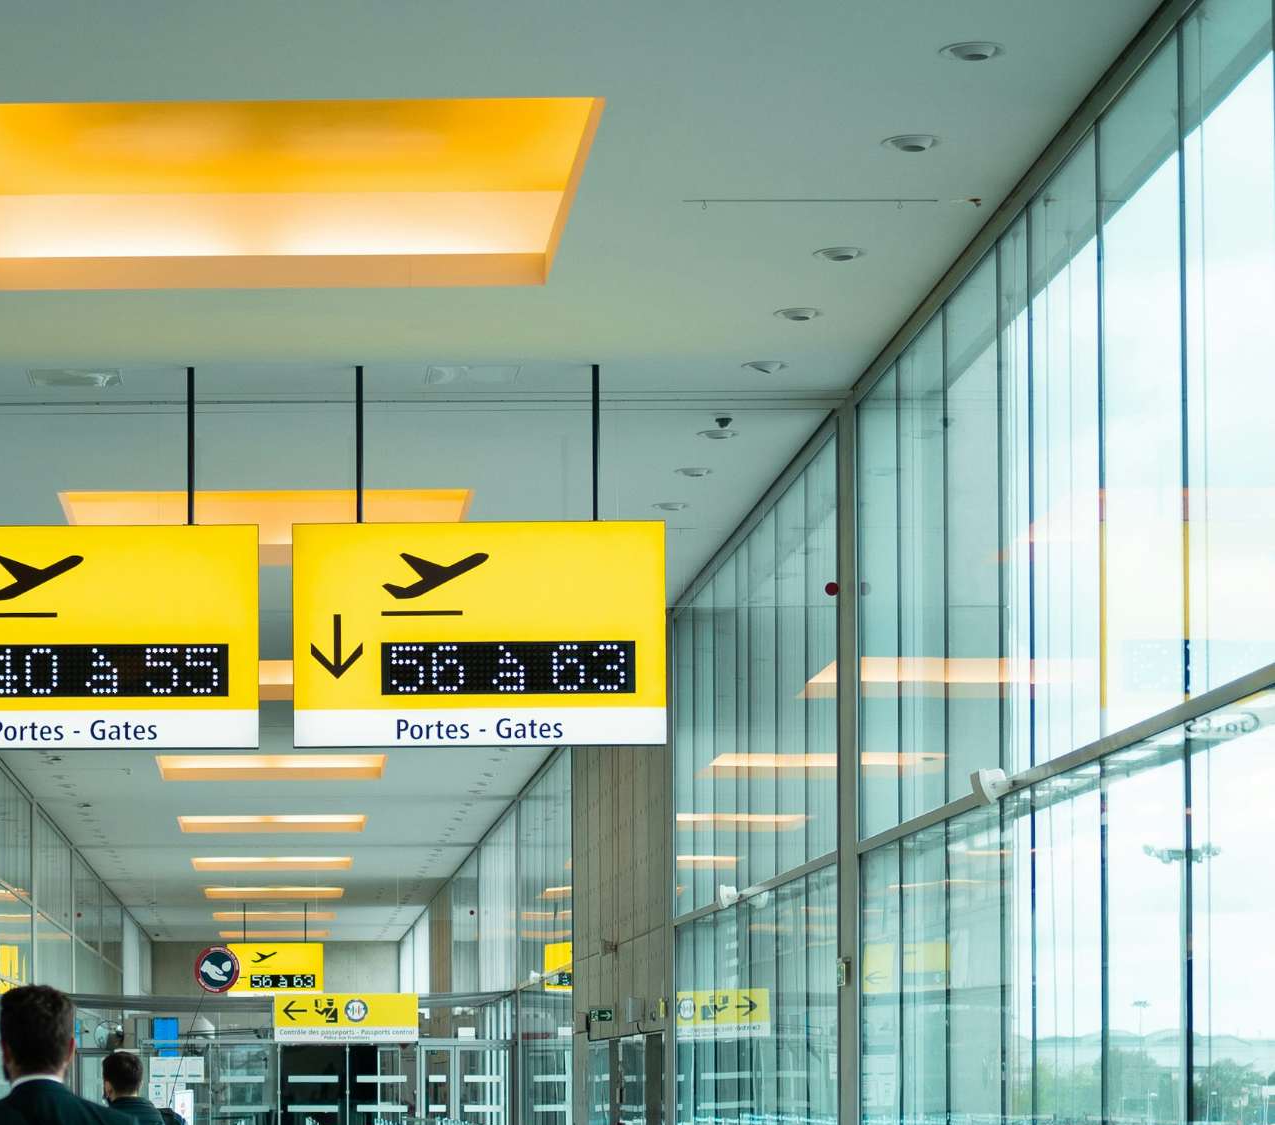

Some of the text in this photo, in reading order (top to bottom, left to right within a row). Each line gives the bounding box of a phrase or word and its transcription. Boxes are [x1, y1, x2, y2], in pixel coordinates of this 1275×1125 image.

[85, 647, 118, 695] à
[144, 647, 220, 694] 55
[390, 645, 627, 693] 56 à 63
[89, 719, 158, 741] Gates
[396, 718, 470, 740] Portes
[495, 717, 563, 739] Gates
[251, 975, 314, 988] 56 à 63
[279, 1028, 307, 1036] Contrôle
[308, 1028, 320, 1036] des
[392, 1028, 415, 1036] control
